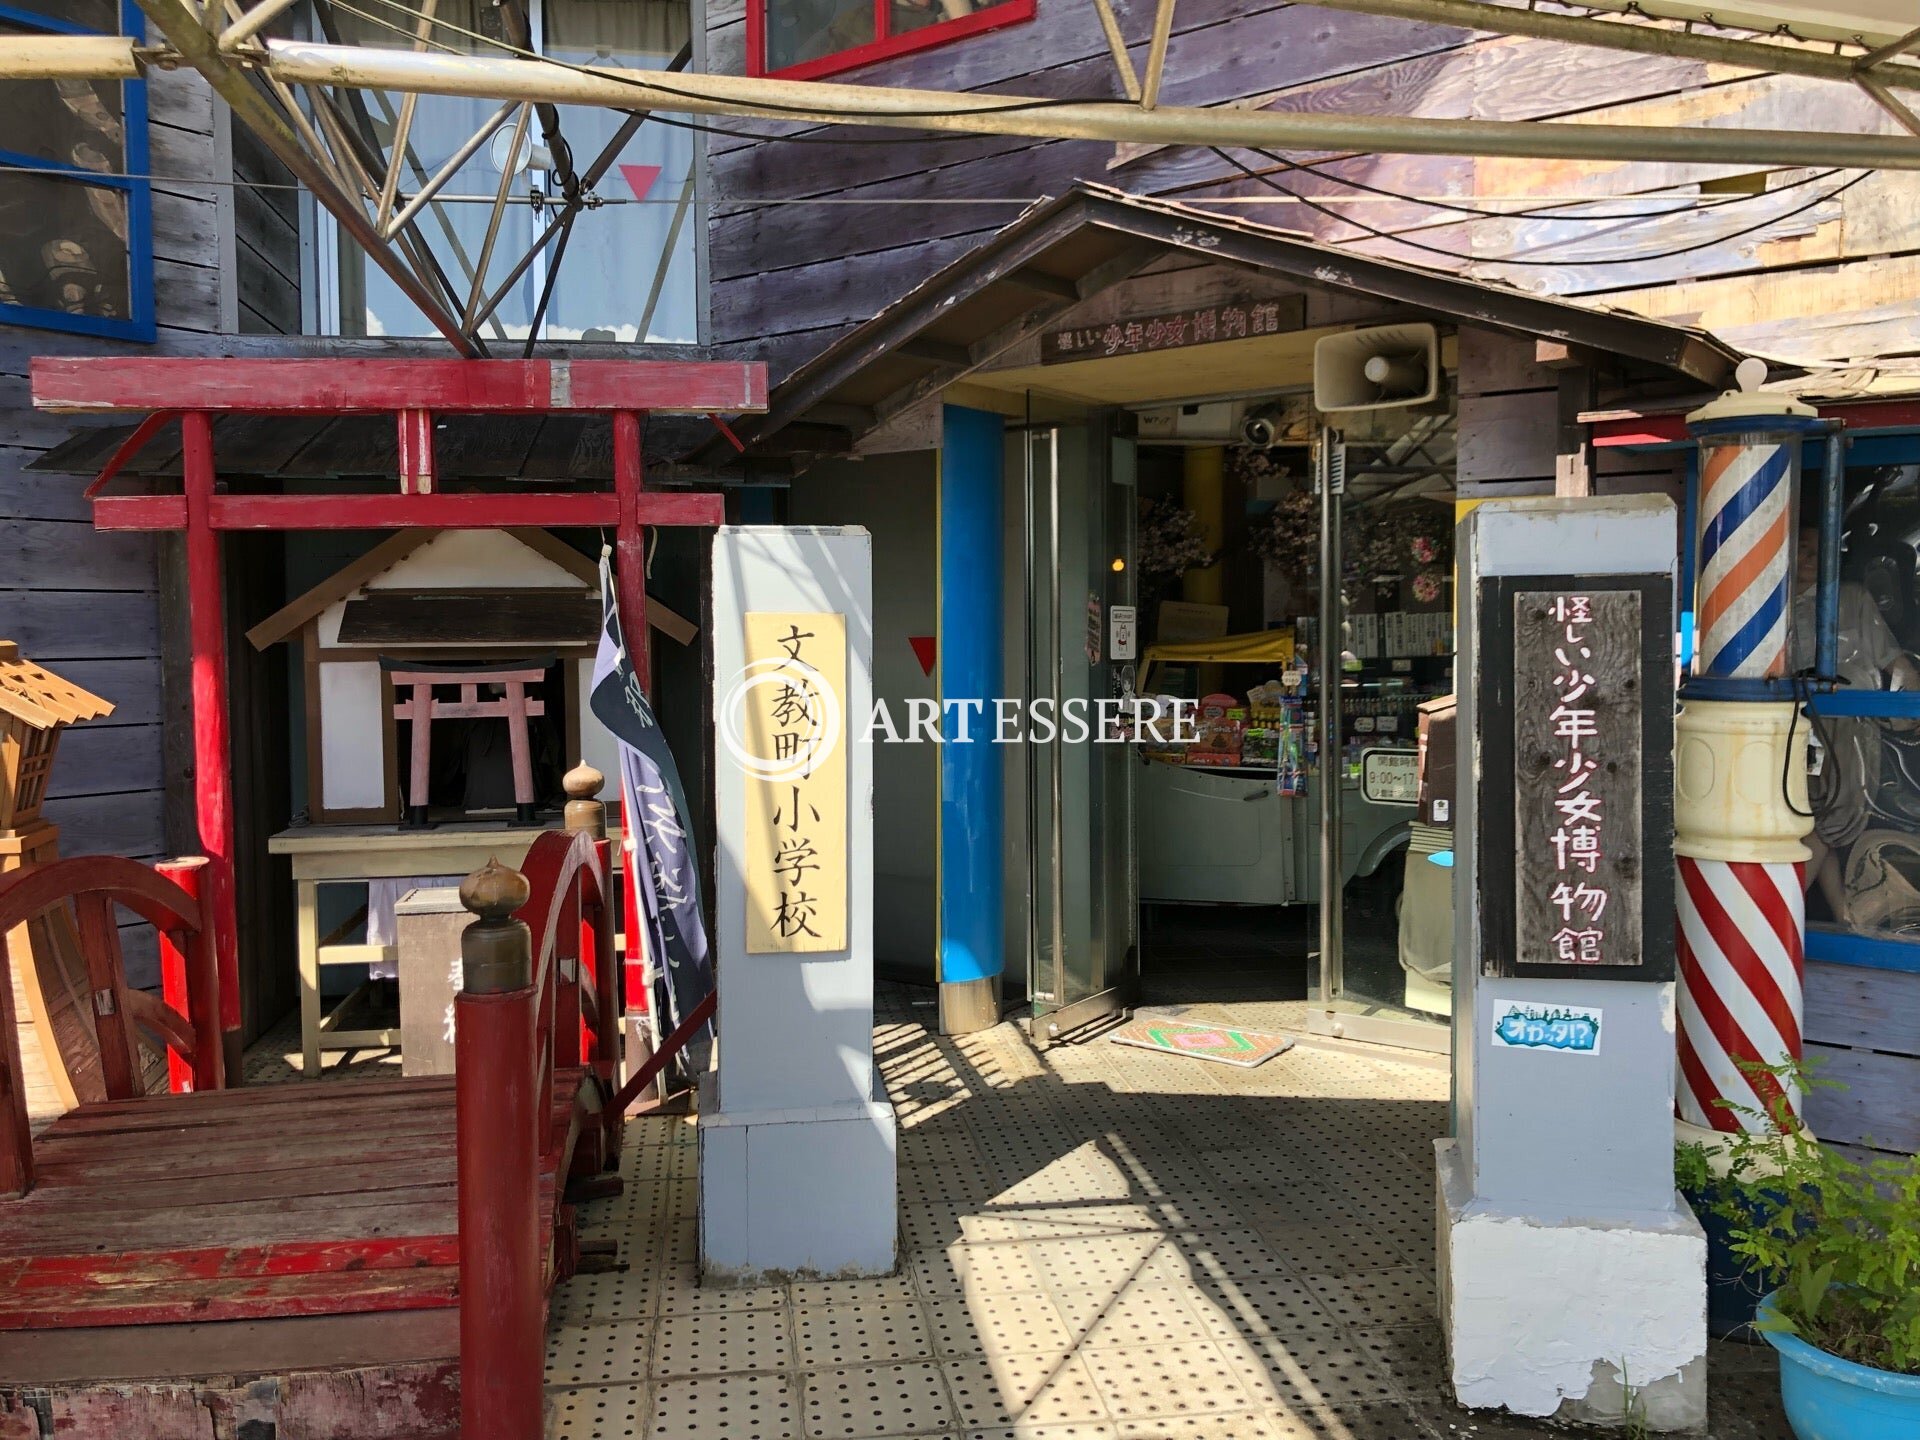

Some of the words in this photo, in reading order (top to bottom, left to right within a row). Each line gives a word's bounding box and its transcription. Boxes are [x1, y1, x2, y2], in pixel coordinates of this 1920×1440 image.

[770, 624, 823, 938] 文教町小学校
[1548, 595, 1607, 962] 怪しい少年少女博物館
